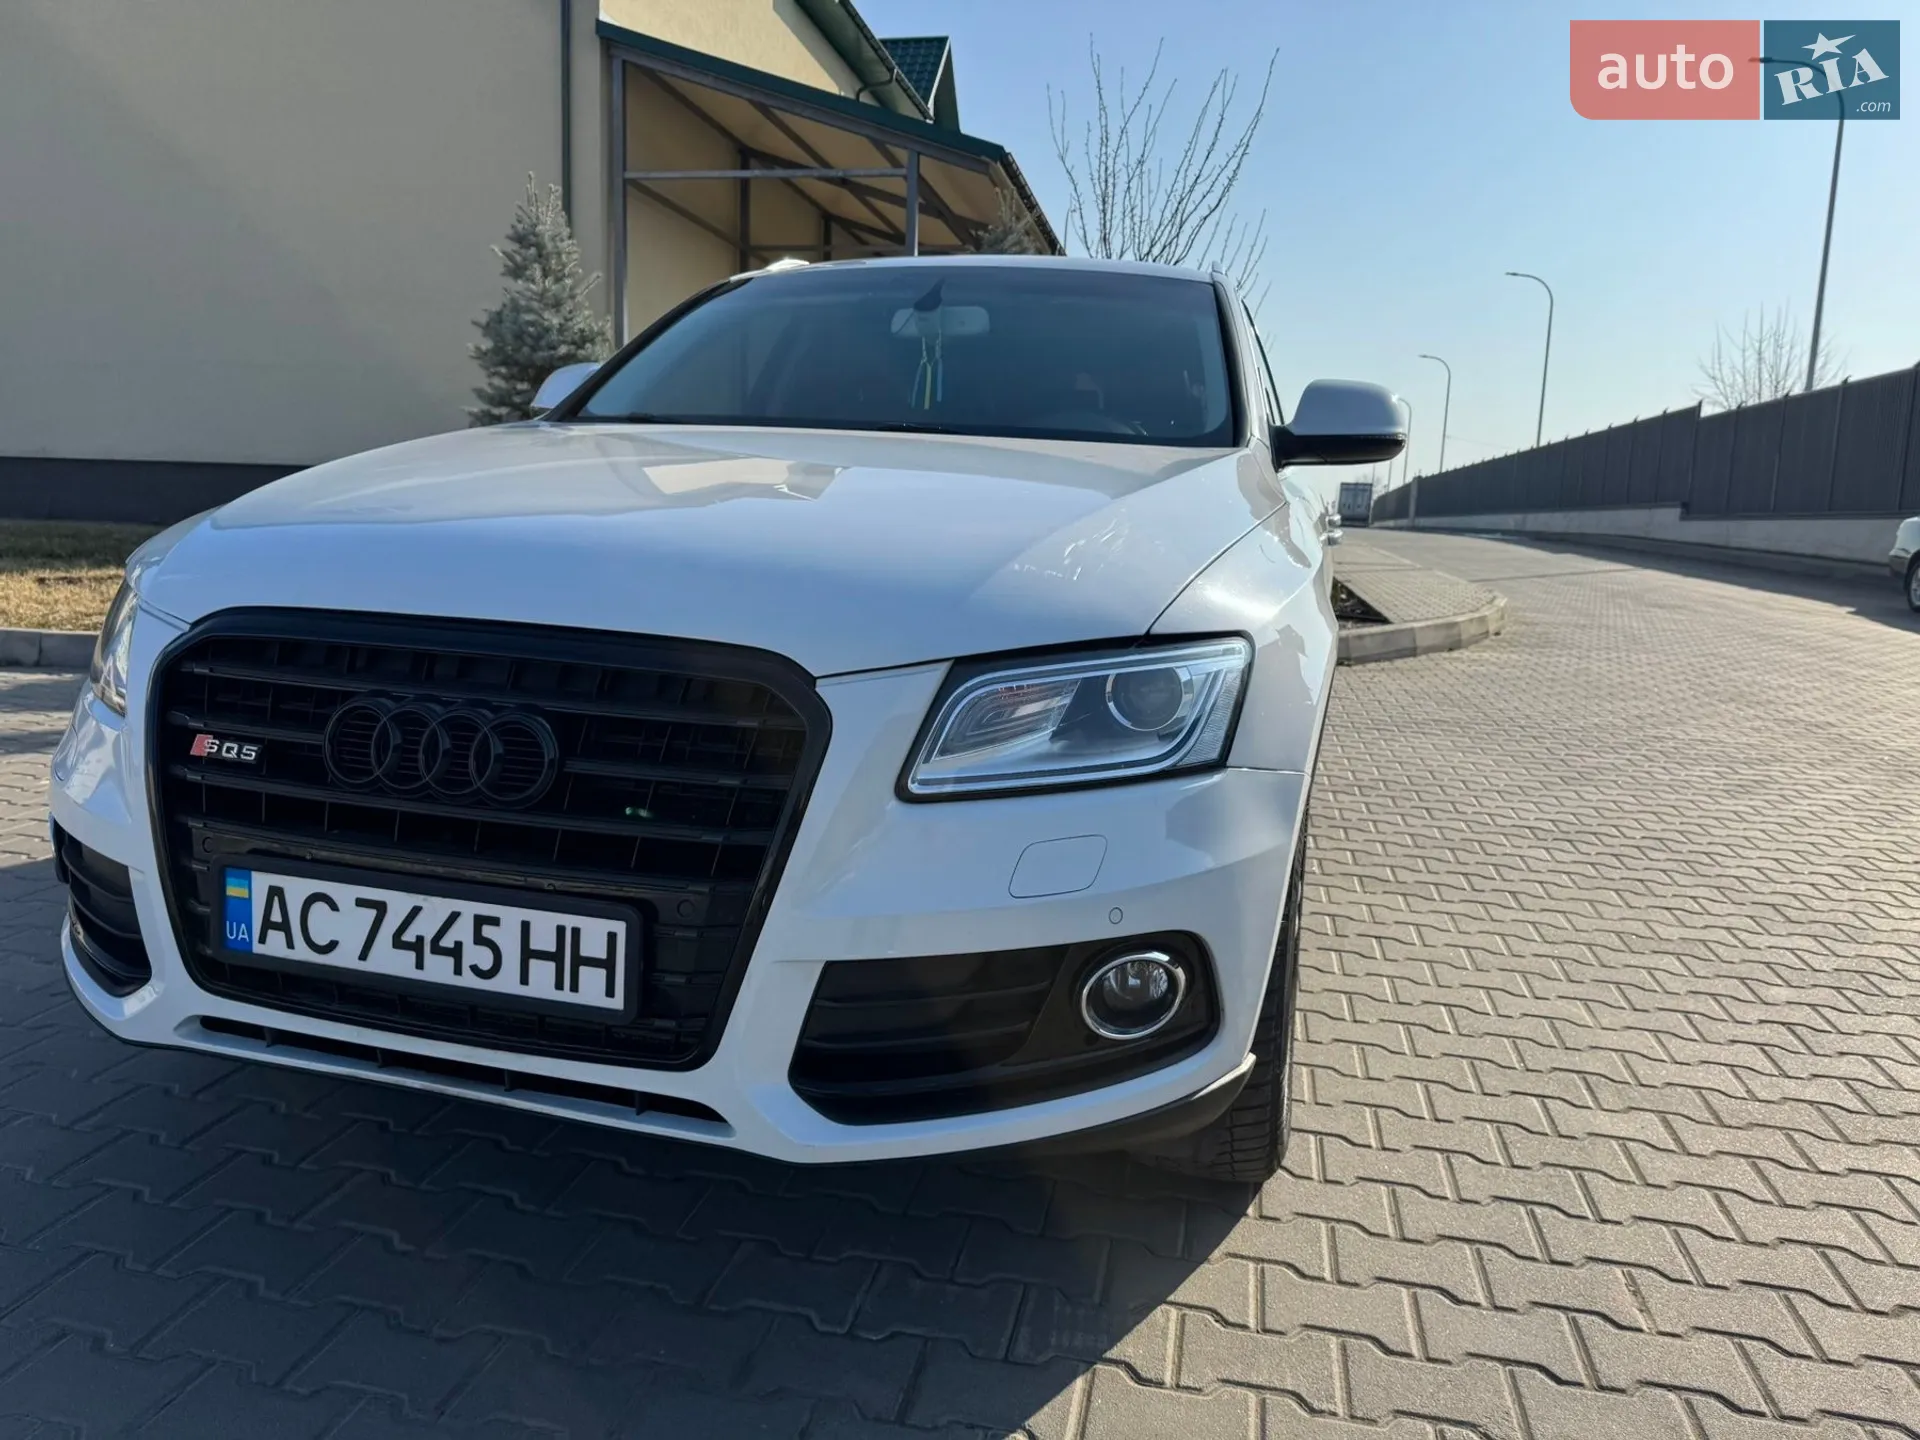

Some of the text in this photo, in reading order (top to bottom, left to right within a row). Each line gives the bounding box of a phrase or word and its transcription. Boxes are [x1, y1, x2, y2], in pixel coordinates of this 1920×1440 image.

[204, 739, 259, 761] SQ5
[226, 920, 249, 943] UA
[257, 885, 618, 998] AC 7445 HH
